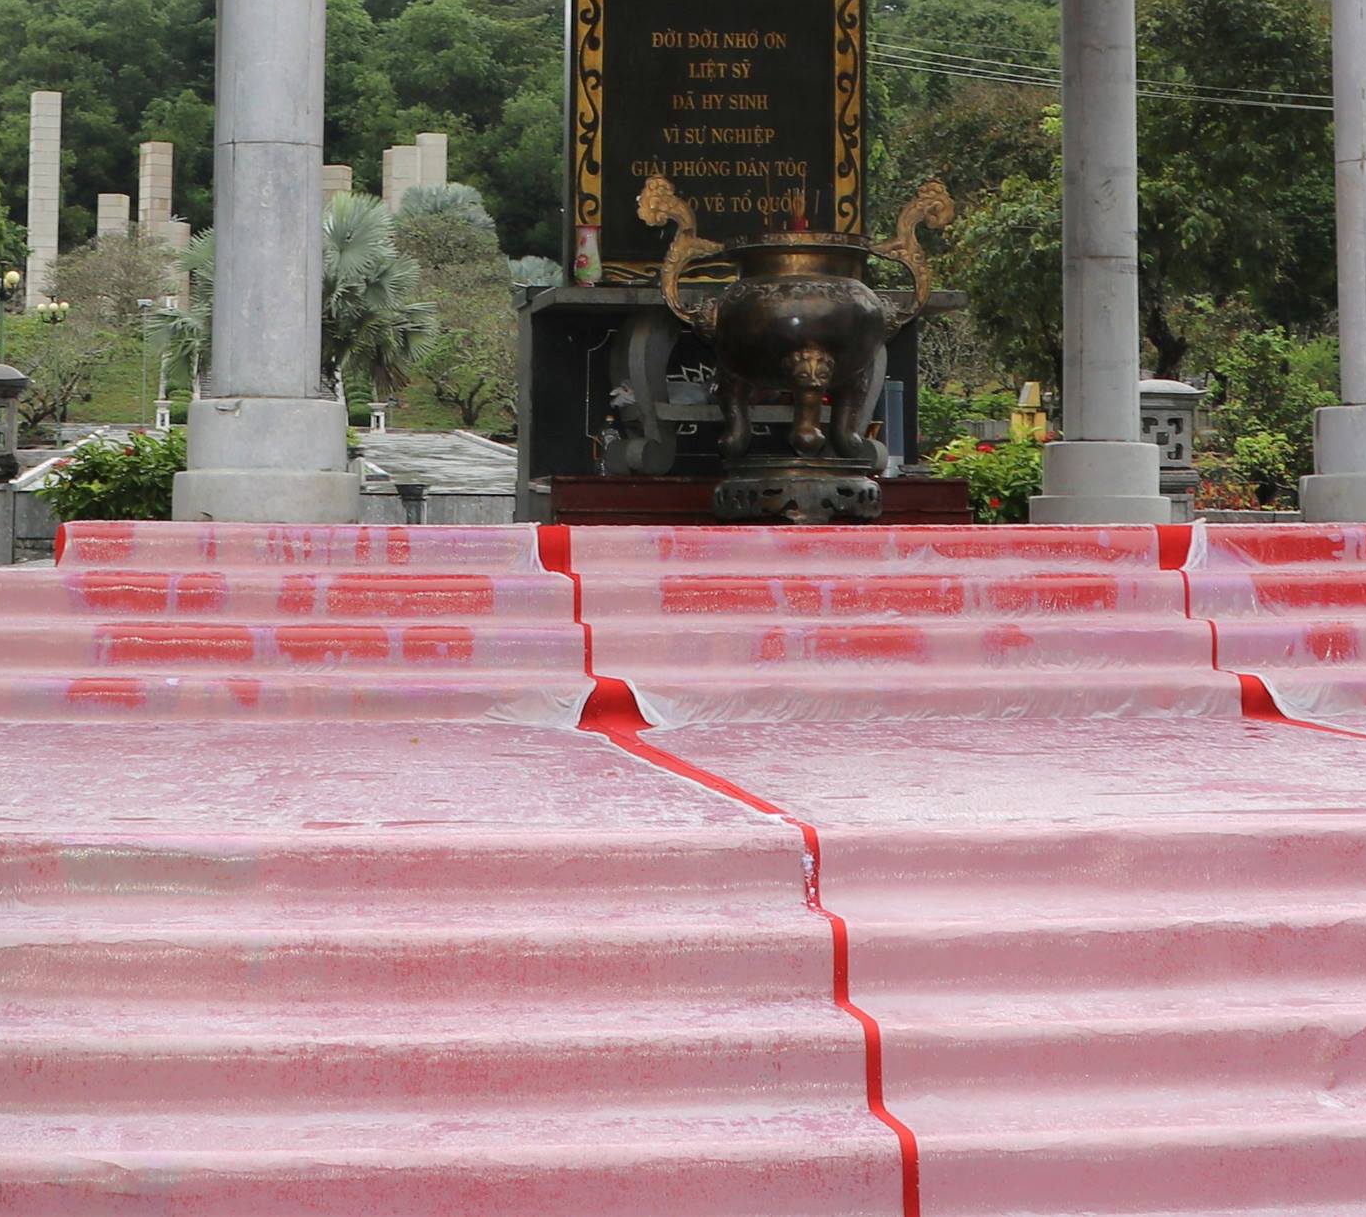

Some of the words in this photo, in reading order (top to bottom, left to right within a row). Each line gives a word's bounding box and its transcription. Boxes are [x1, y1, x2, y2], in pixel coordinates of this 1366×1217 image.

[651, 28, 682, 48] ĐỜI
[688, 28, 719, 49] ĐỜI
[723, 29, 759, 49] NHỚ
[764, 30, 787, 48] ƠN
[688, 58, 727, 82] LIỆT
[672, 90, 695, 110] ĐÃ
[702, 94, 724, 110] HY
[729, 94, 768, 110] SINH
[662, 124, 680, 144] VÌ
[685, 124, 707, 147] SỰ
[711, 124, 775, 147] NGHIỆP
[673, 157, 731, 176] PHÓNG
[736, 157, 769, 176] DÂN
[731, 189, 752, 213] TỔ
[757, 191, 805, 215] QUỐ
